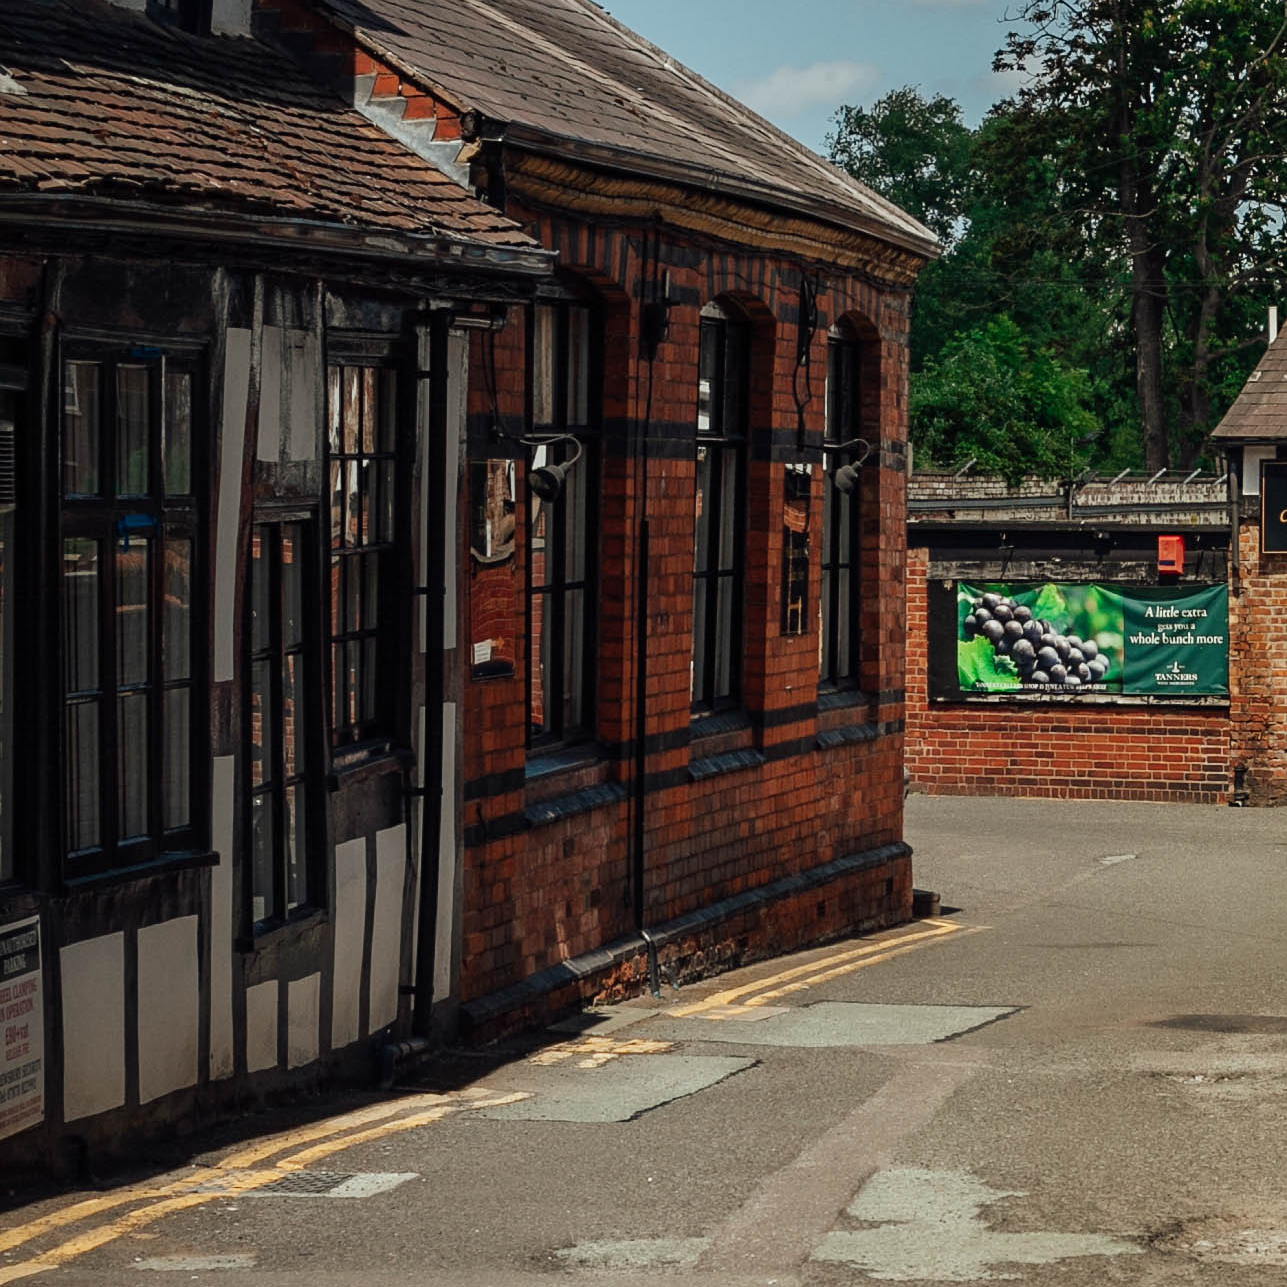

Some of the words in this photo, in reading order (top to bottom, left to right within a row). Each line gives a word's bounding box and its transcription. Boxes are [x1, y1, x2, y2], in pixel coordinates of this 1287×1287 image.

[1144, 606, 1154, 618] A
[1155, 605, 1179, 618] little
[1181, 608, 1208, 618] extra
[1173, 623, 1189, 633] you
[1129, 631, 1160, 644] whole
[1161, 632, 1194, 644] bunch
[1196, 635, 1224, 644] more
[1154, 673, 1198, 681] TANNERS
